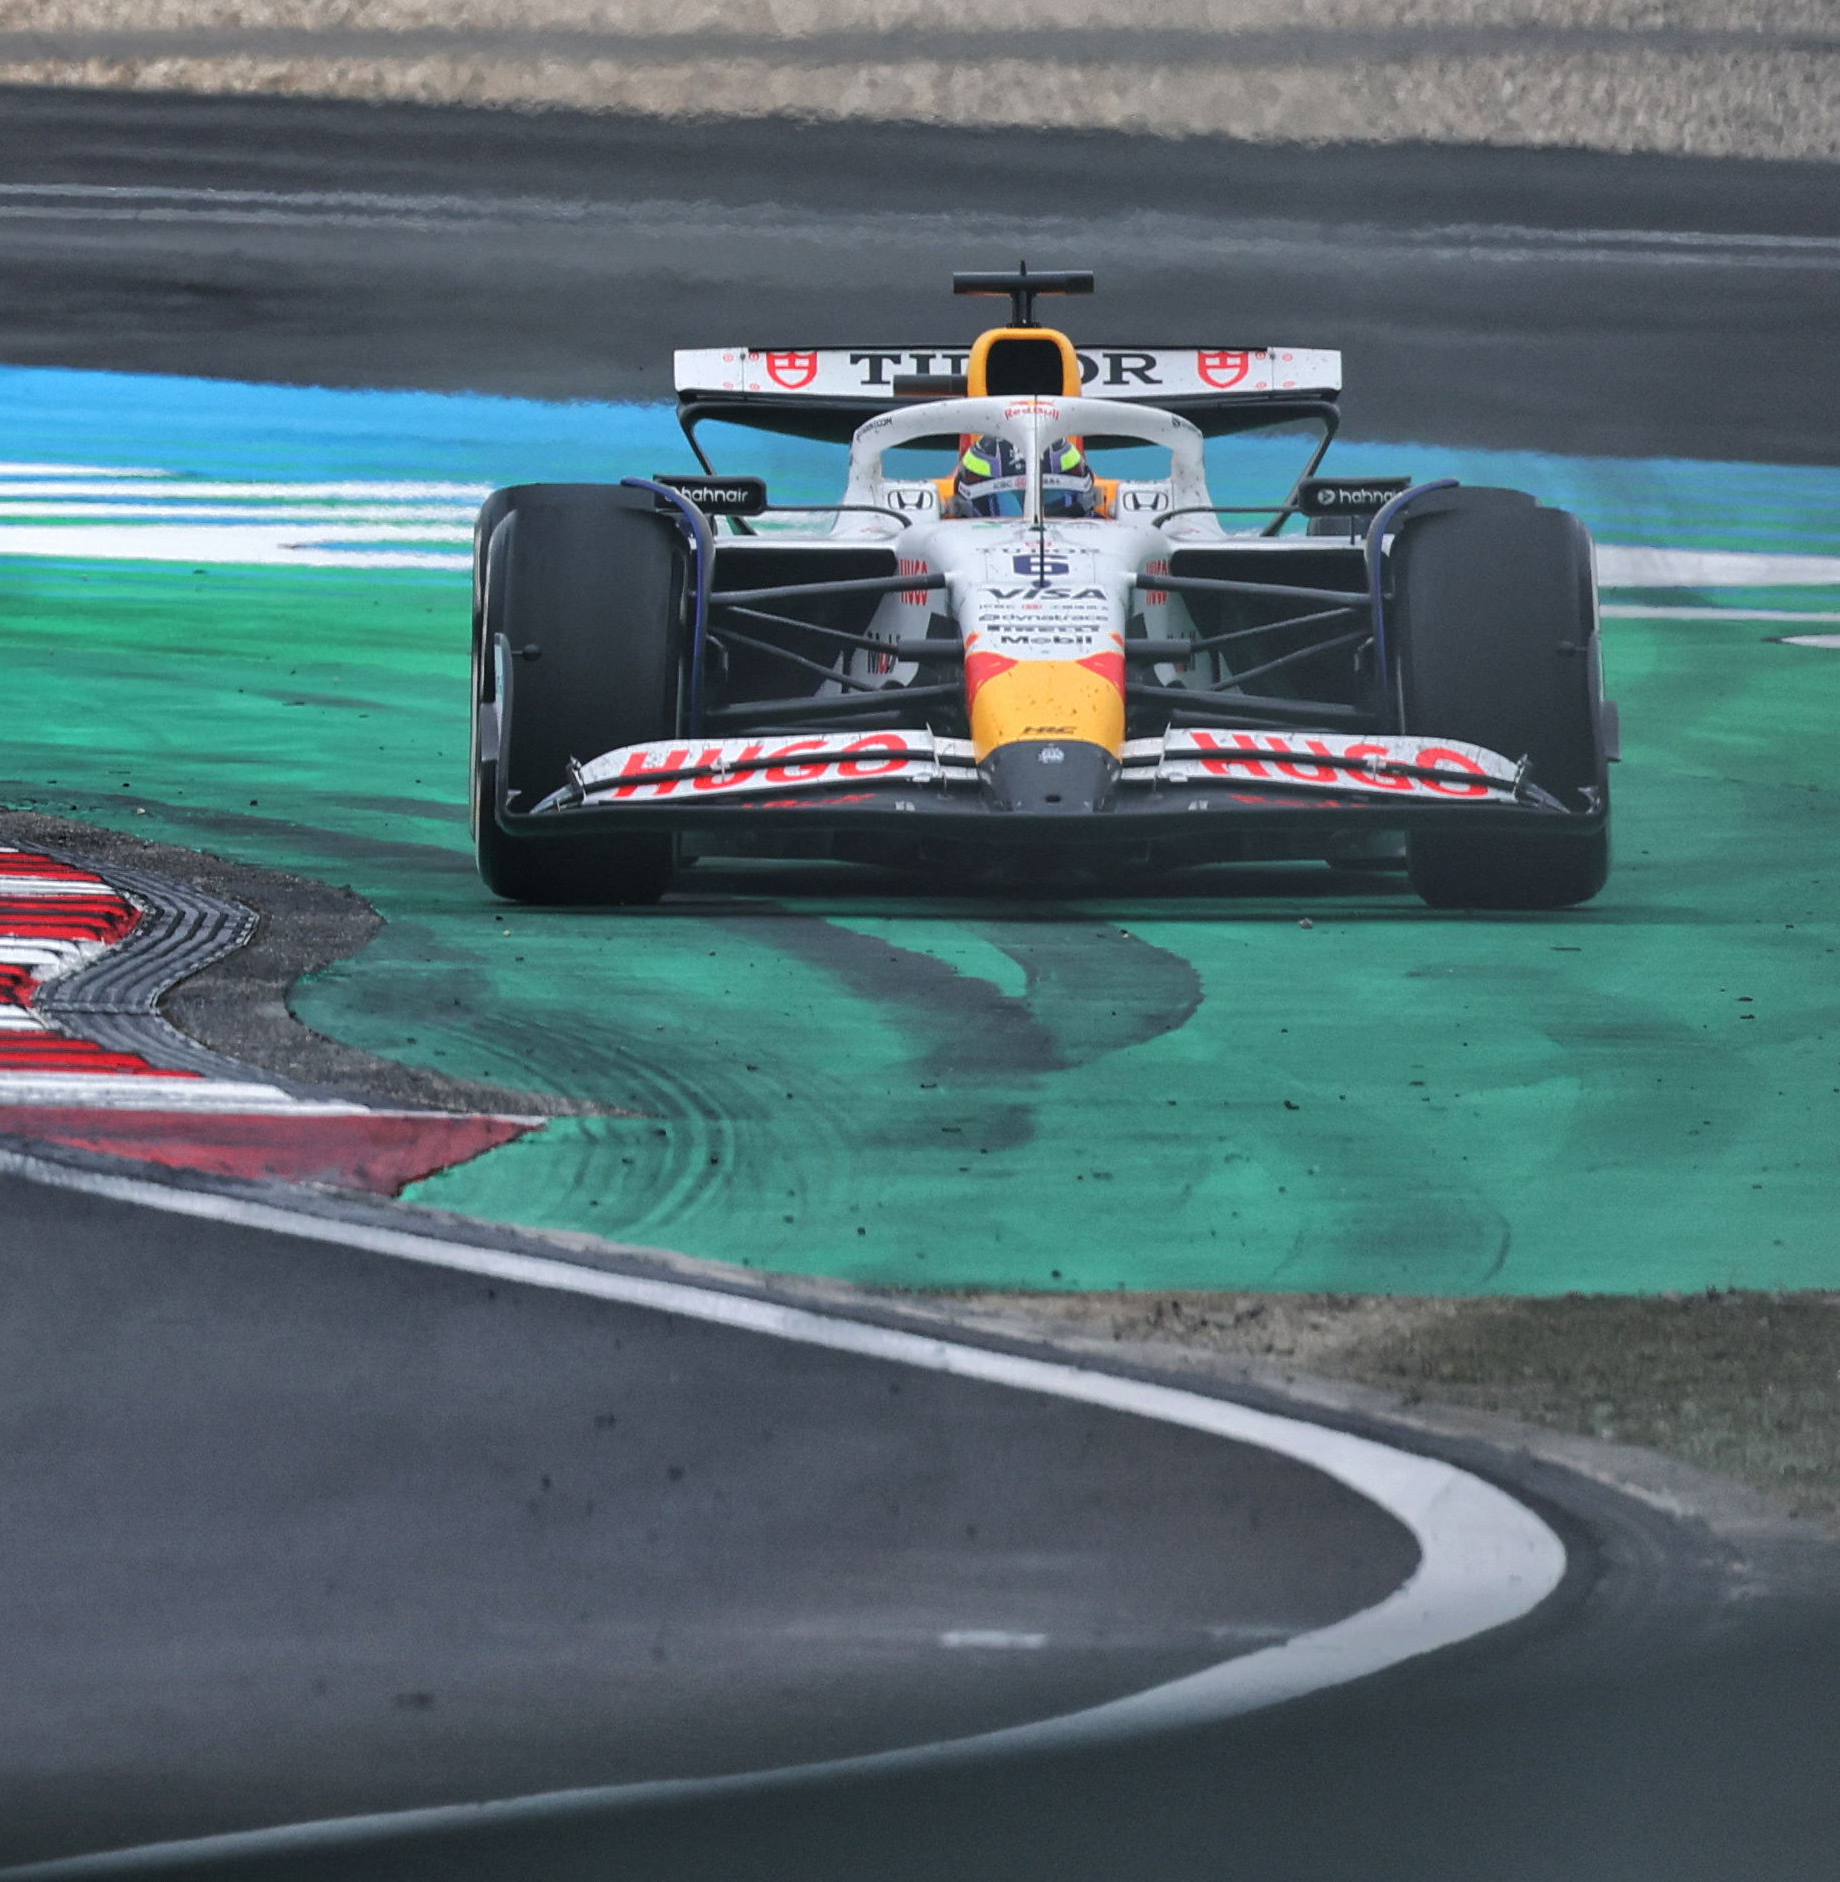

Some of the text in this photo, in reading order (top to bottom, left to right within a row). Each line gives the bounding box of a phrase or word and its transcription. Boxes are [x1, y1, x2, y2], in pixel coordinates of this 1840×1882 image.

[682, 486, 748, 503] hahnair
[1013, 555, 1069, 576] 6
[979, 588, 1107, 600] VISA
[1002, 613, 1109, 622] dynatrace
[1001, 636, 1092, 644] Mobil
[612, 733, 908, 798] HUGO
[1191, 732, 1489, 798] HUGO
